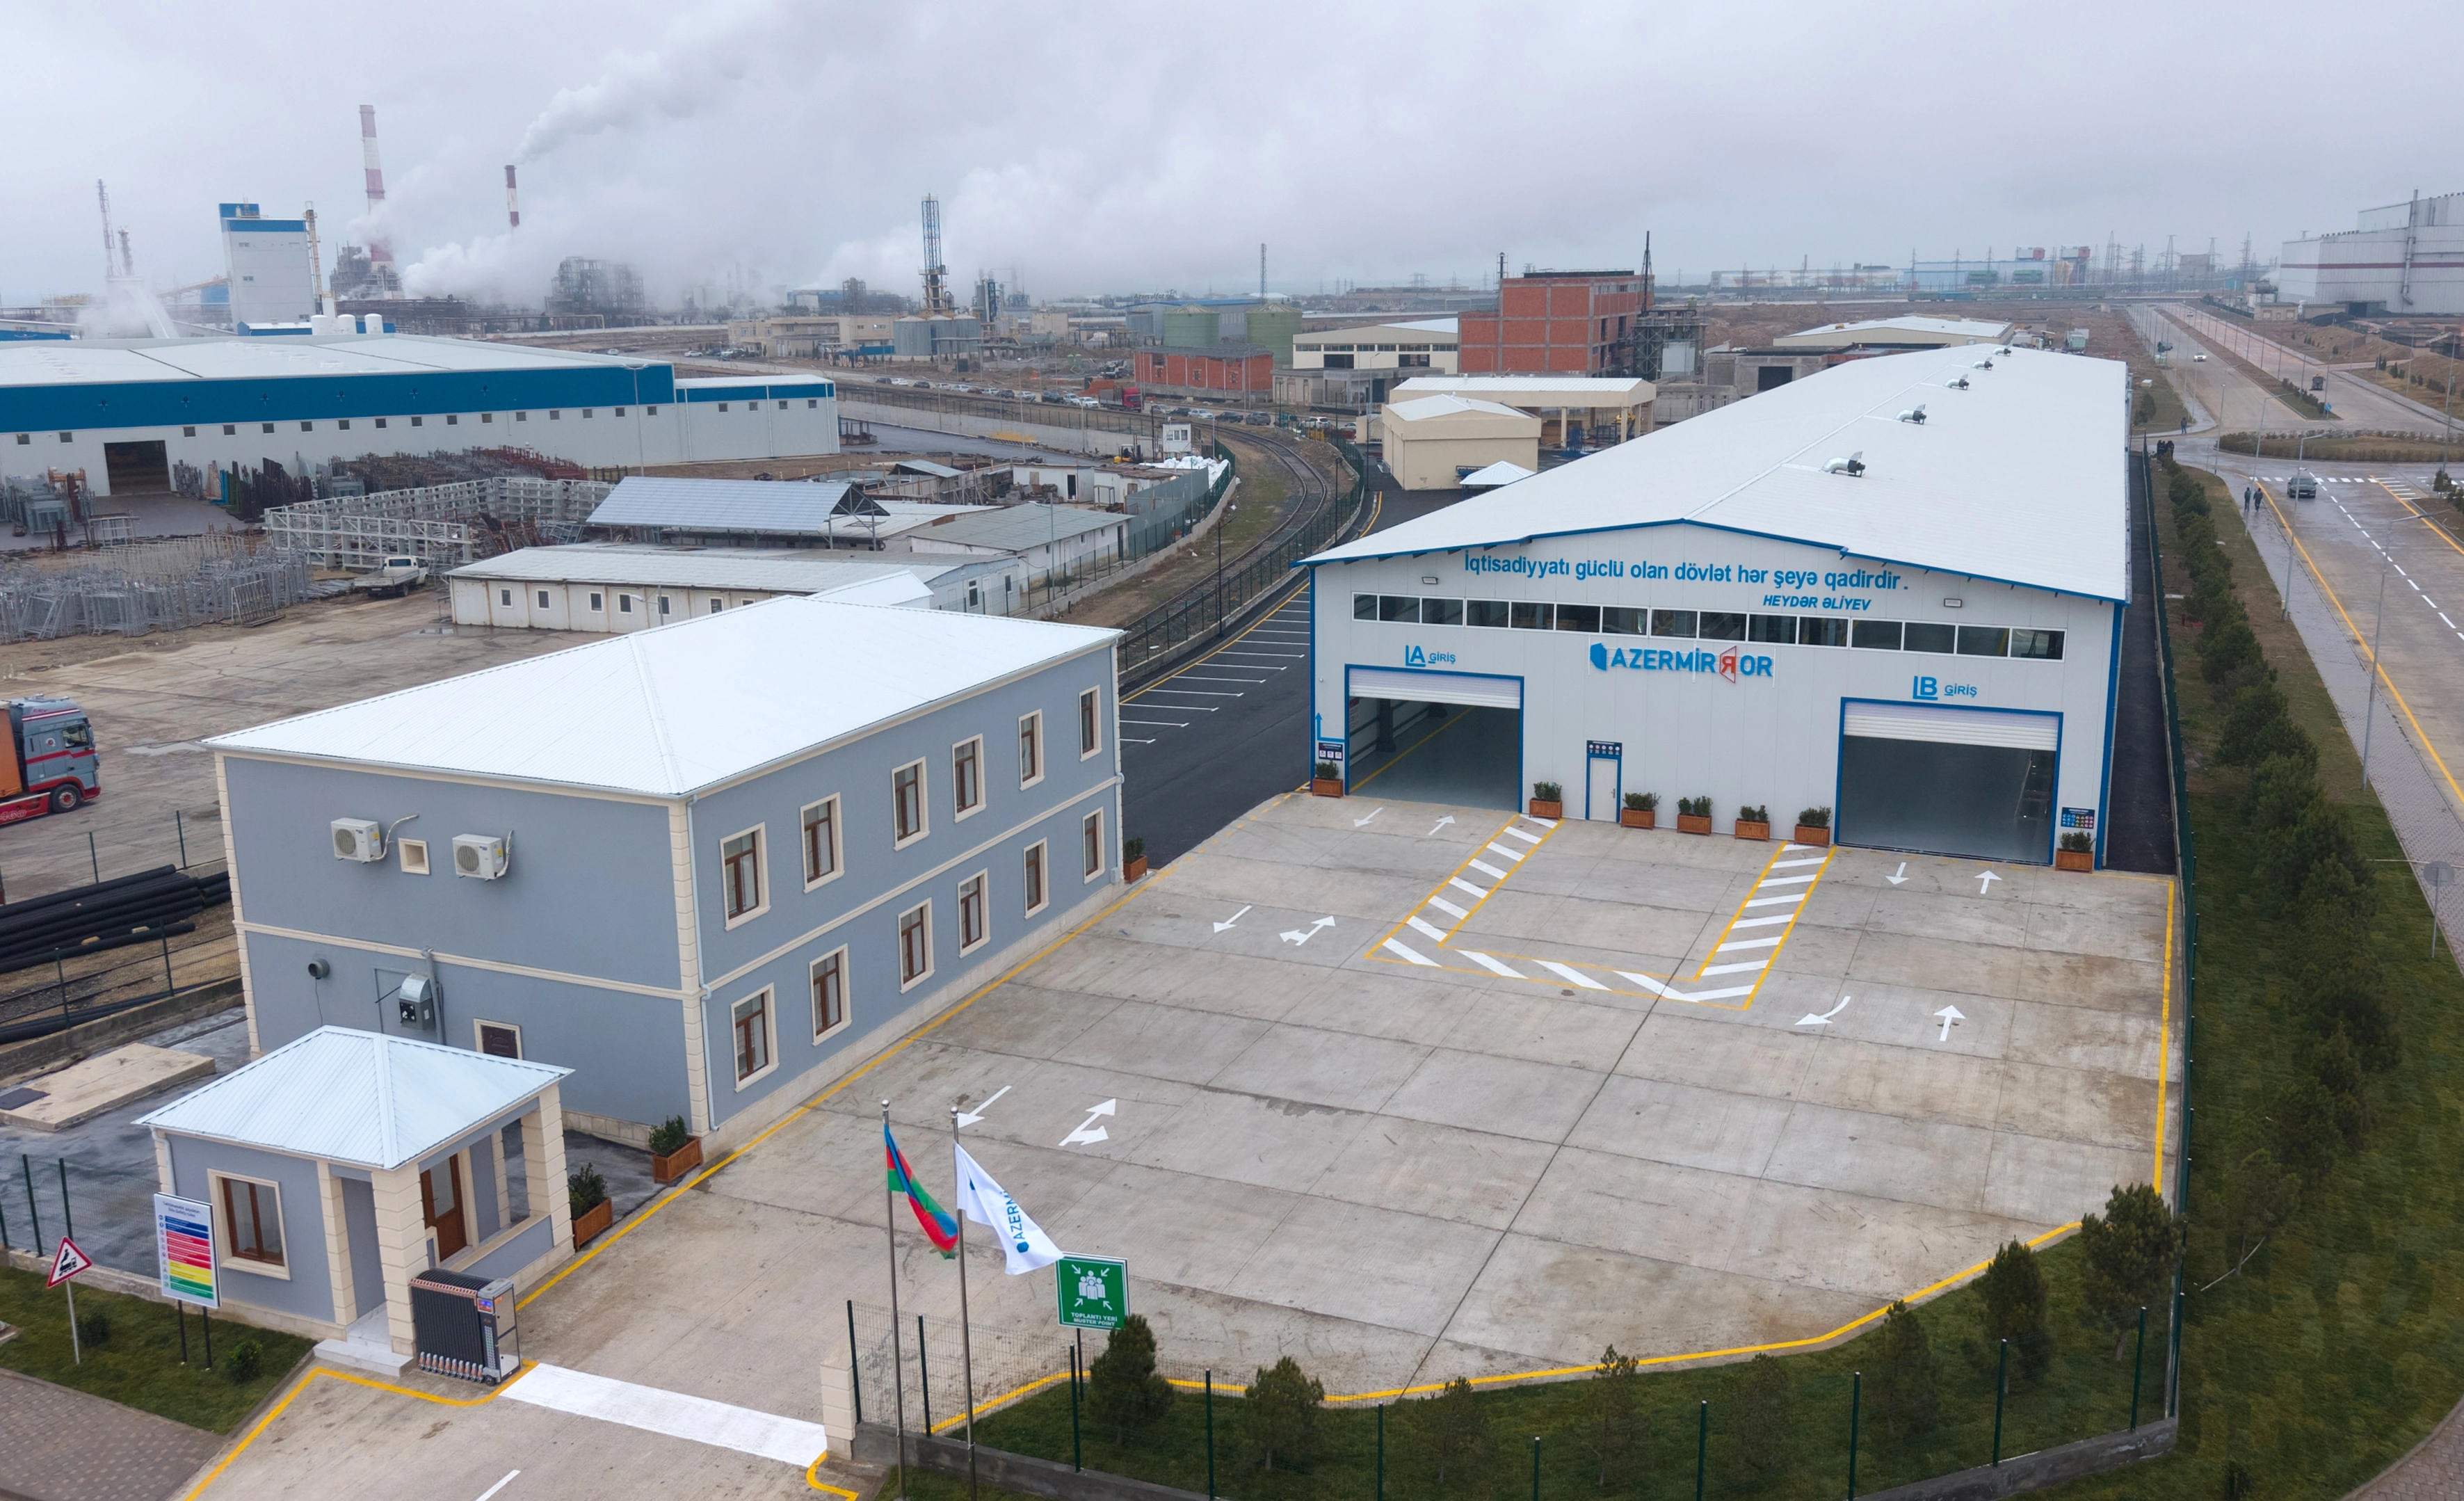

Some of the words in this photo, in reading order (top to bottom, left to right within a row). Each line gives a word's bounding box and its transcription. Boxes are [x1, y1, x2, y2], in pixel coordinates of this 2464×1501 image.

[1465, 550, 1570, 579] İqtisadiyyatı
[1575, 560, 1624, 581] güclü
[1630, 561, 1668, 579] olan
[1674, 562, 1732, 582] dövlət
[1737, 565, 1769, 584] hər
[1773, 570, 1819, 590] şeyə
[1762, 595, 1819, 609] HEYDƏR
[1822, 596, 1871, 611] ƏLİYEV
